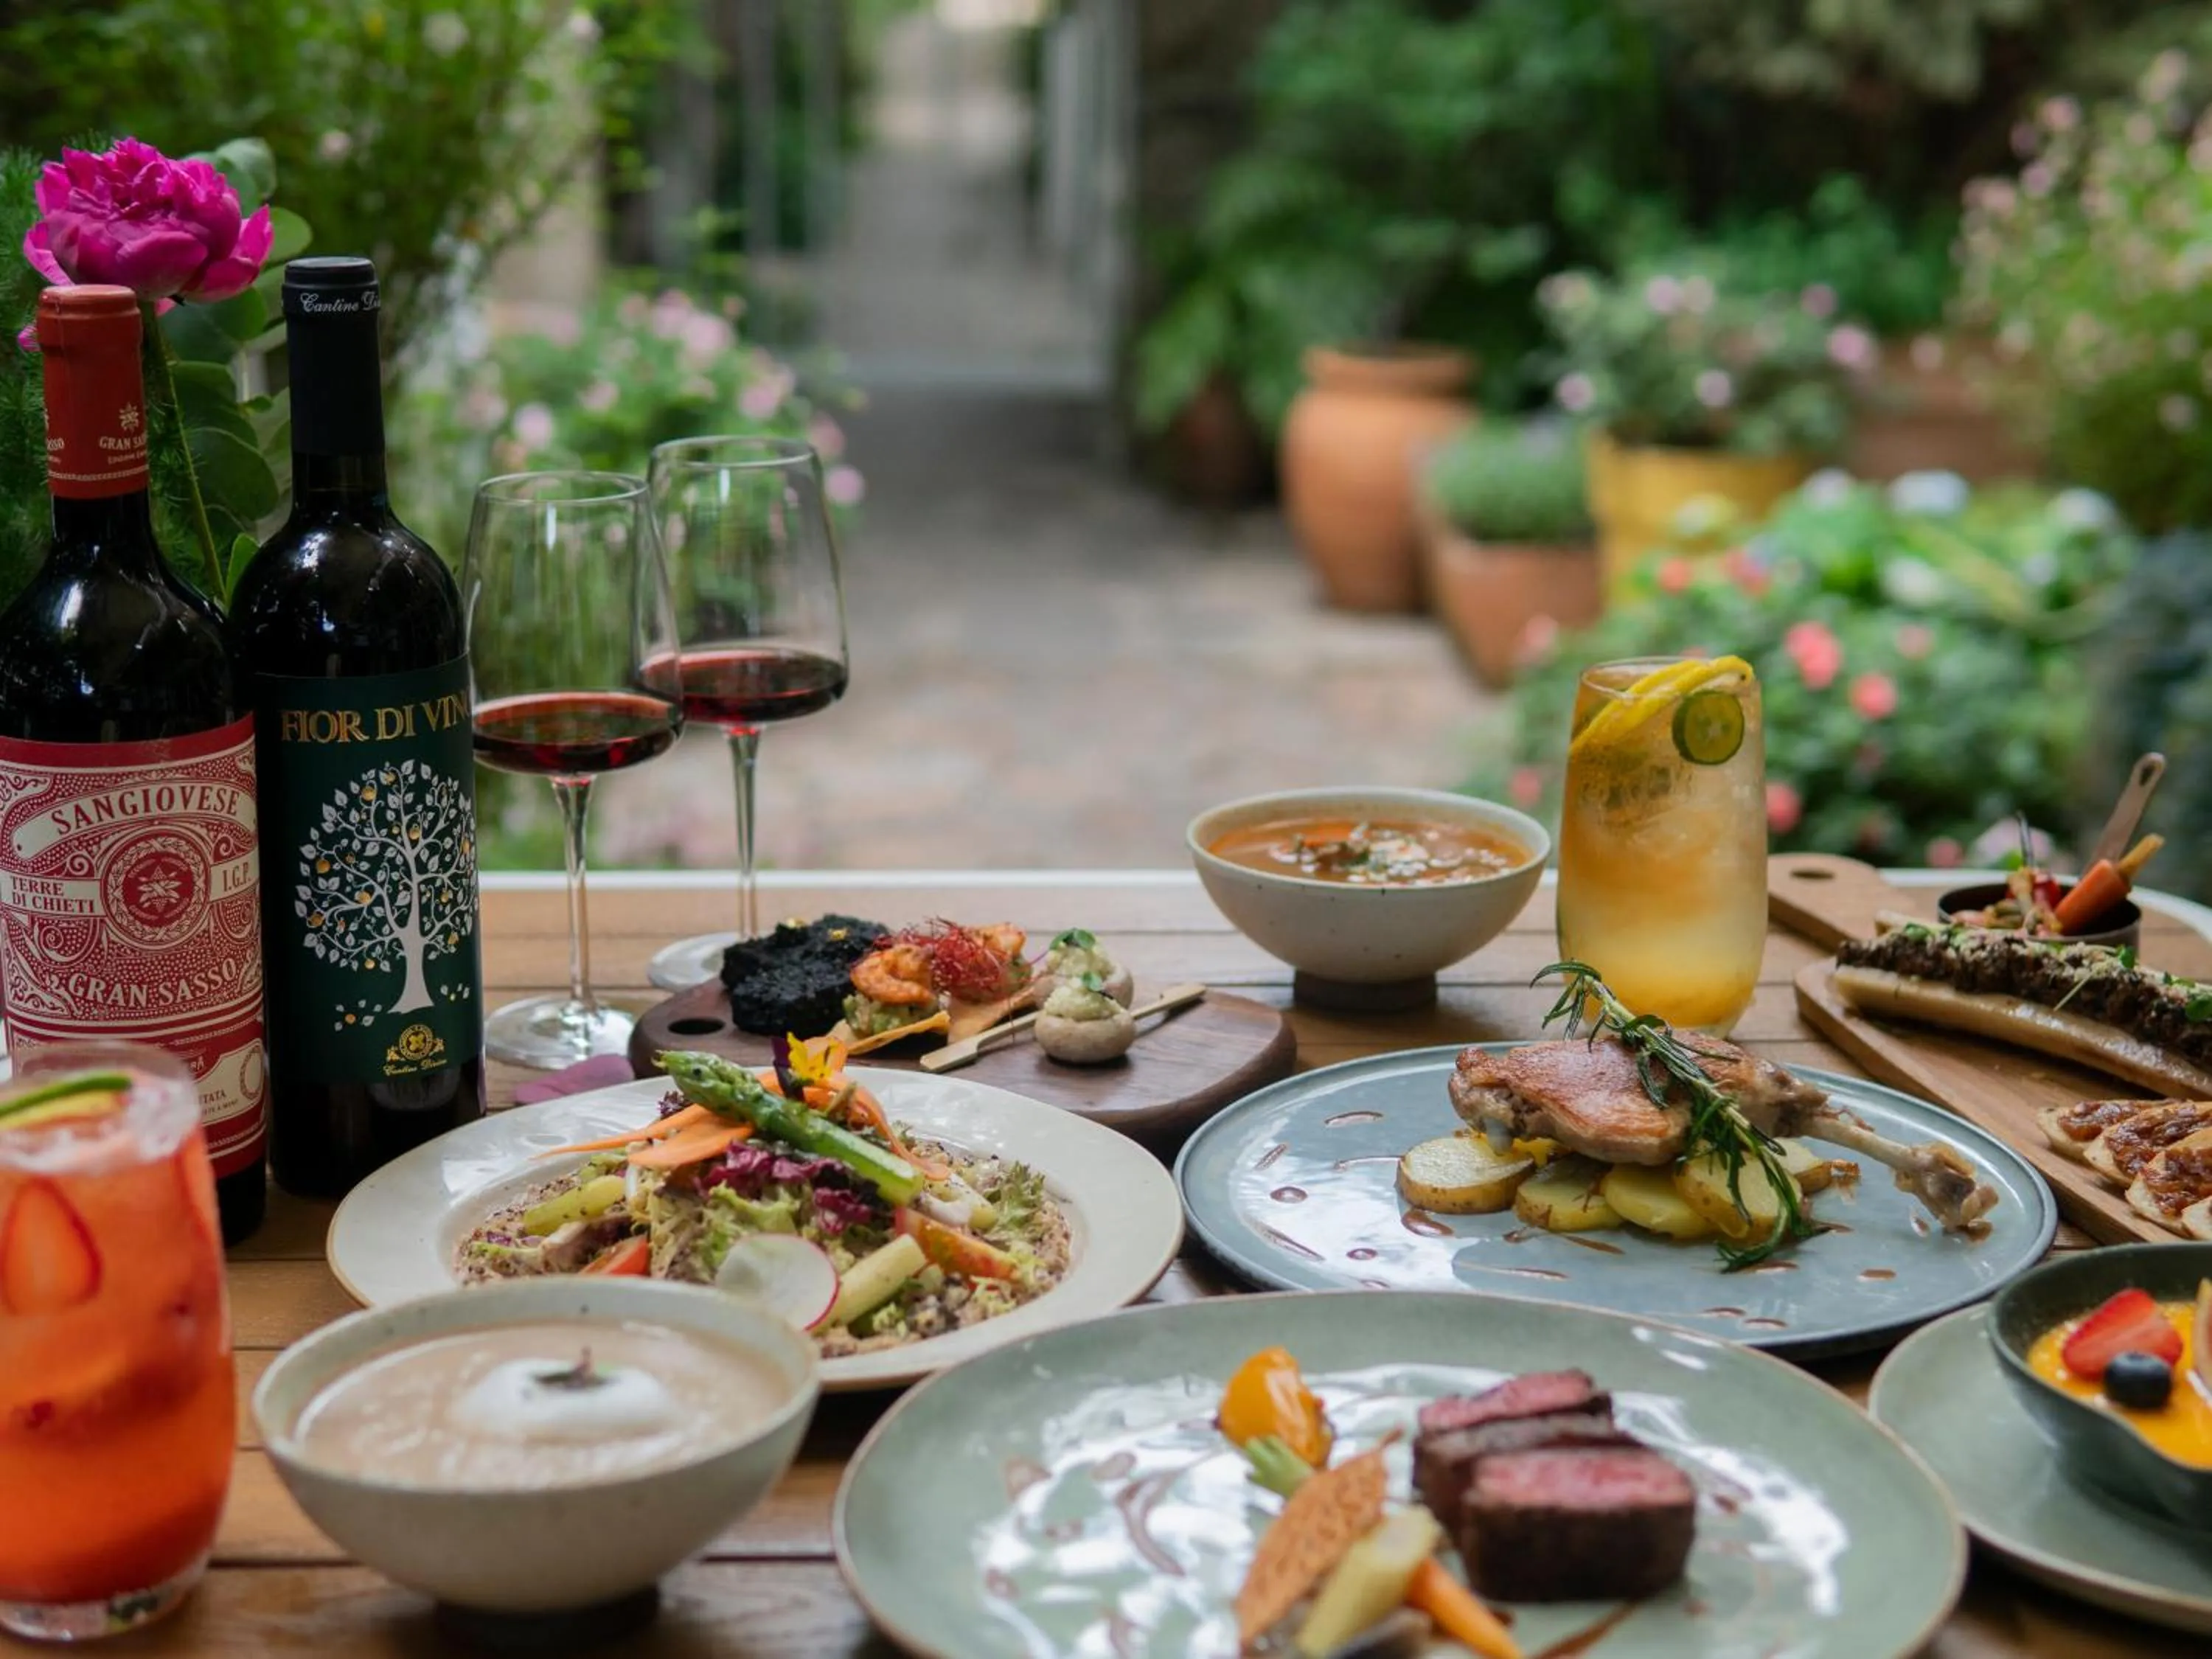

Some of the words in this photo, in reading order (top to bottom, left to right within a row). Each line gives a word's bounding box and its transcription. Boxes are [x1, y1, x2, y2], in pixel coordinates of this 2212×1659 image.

[99, 436, 131, 451] GRAN
[281, 709, 370, 744] FIOR
[375, 705, 417, 741] DI
[51, 785, 240, 836] SANGIOVESE
[11, 875, 64, 897] TERRE
[222, 862, 251, 892] I.G.P.
[13, 891, 27, 908] DI
[32, 895, 94, 914] CHIETI
[69, 973, 147, 1008] GRAN
[159, 958, 237, 1006] SASSO
